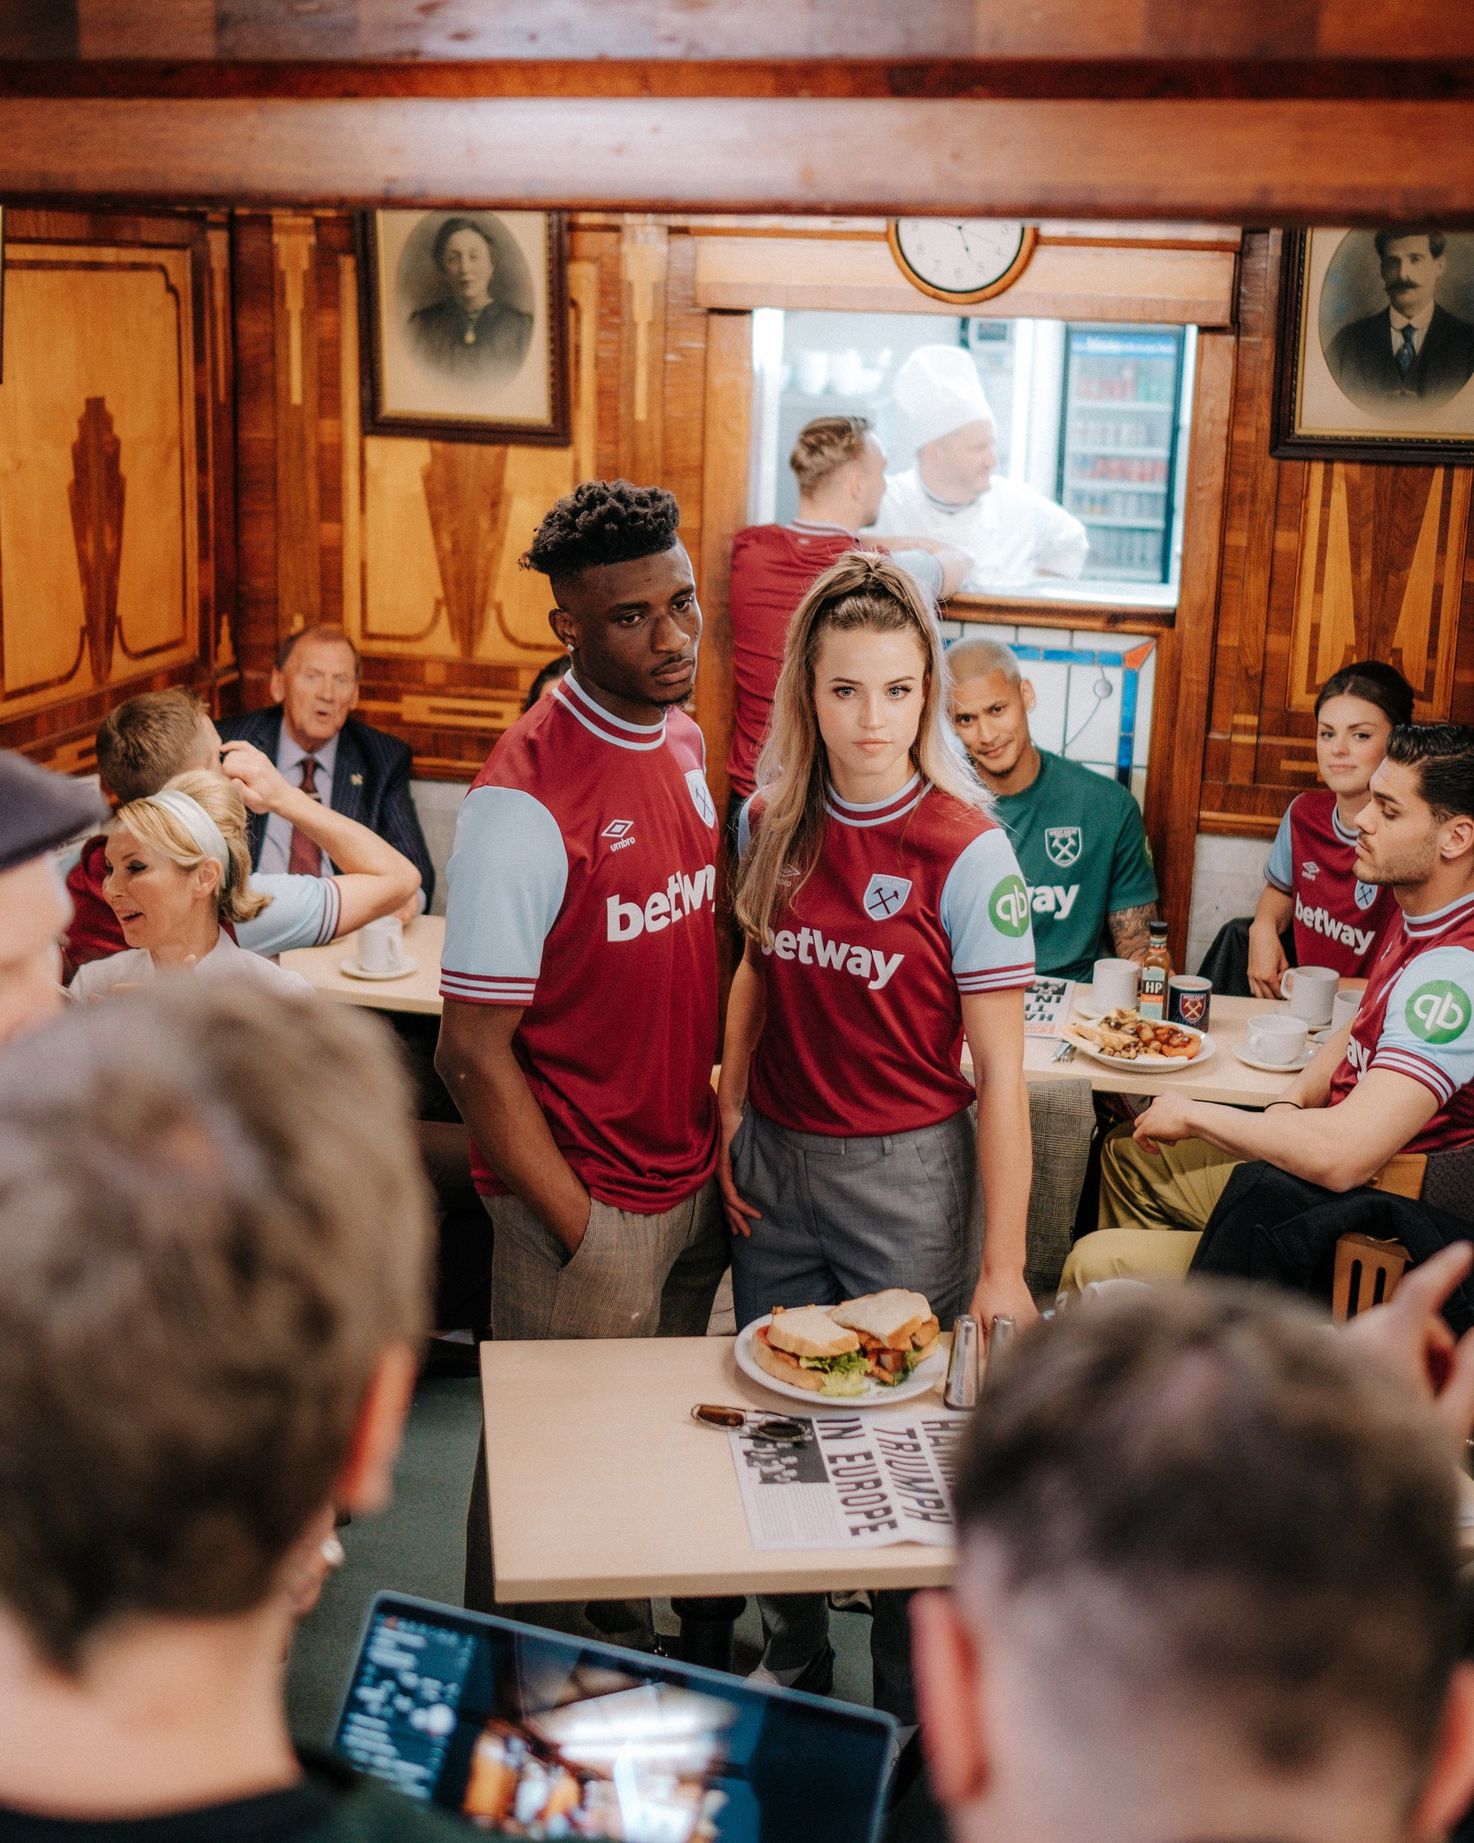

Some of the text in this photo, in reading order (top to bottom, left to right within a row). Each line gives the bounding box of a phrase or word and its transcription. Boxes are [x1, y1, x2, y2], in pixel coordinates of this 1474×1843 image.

[610, 836, 635, 852] umbro
[606, 864, 716, 942] betw
[1295, 892, 1376, 956] betway
[1145, 981, 1163, 994] HP
[815, 1416, 899, 1537] IN EUROPE
[872, 1427, 953, 1524] TRIUMPH
